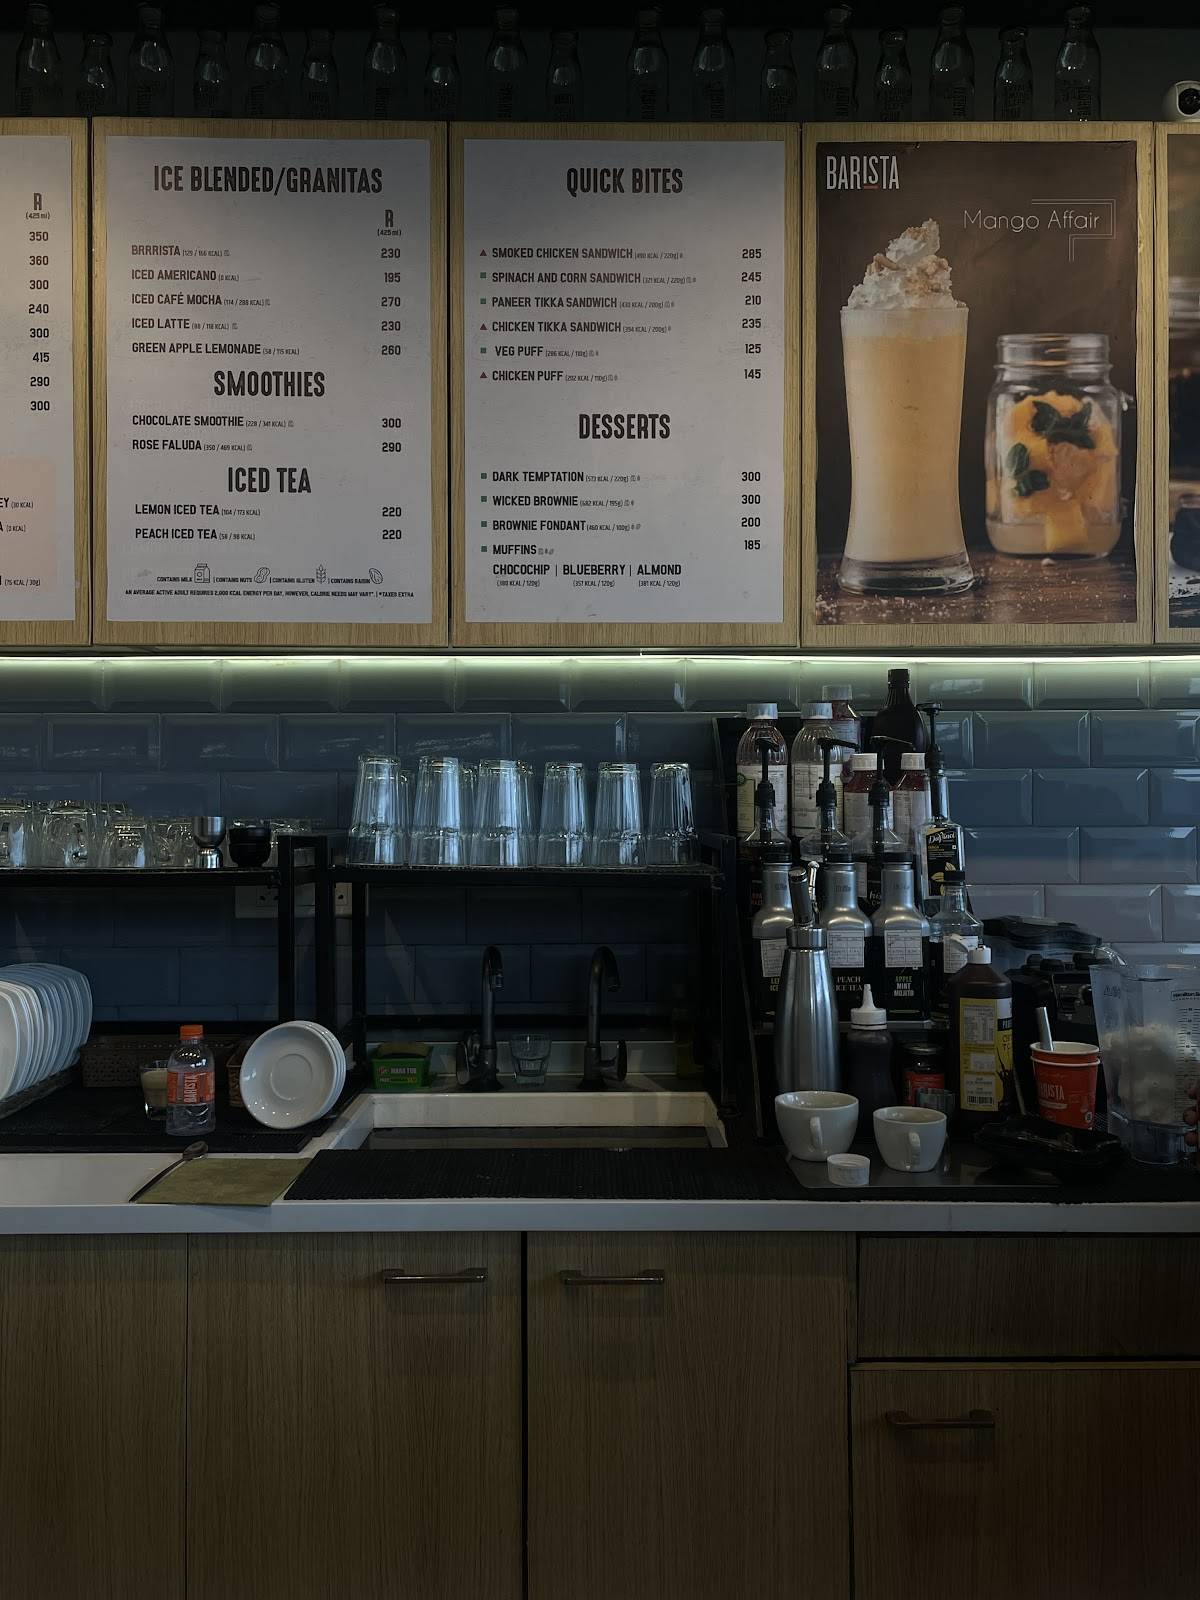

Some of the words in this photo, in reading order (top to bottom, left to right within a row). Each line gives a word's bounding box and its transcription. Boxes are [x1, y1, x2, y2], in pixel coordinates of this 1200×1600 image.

[826, 155, 900, 189] BARISTA
[154, 166, 183, 191] ICE
[191, 166, 382, 196] BLENDED/GRANITAS
[567, 168, 624, 197] QUICK
[632, 168, 683, 193] BITES
[34, 193, 42, 210] R
[385, 209, 393, 227] R
[964, 209, 1040, 232] Mango
[1047, 209, 1101, 230] Affair
[29, 232, 48, 241] 350
[132, 245, 180, 256] BRRRISTA
[381, 248, 400, 258] 230
[492, 248, 533, 258] SMOKED
[536, 248, 578, 258] CHICKEN
[582, 248, 632, 258] SANDWICH
[742, 249, 761, 259] 285
[30, 256, 48, 265] 360
[132, 269, 154, 279] ICED
[158, 270, 216, 280] AMERICANO
[384, 272, 400, 283] 195
[492, 272, 534, 283] SPINACH
[538, 273, 557, 283] AND
[560, 273, 587, 283] CORN
[590, 273, 640, 283] SANDWICH
[742, 272, 761, 282] 245
[30, 280, 48, 289] 300
[132, 294, 154, 304] ICED
[158, 292, 184, 304] CAFÉ
[187, 294, 222, 305] MOCHA
[381, 297, 400, 307] 270
[492, 297, 531, 307] PANEER
[535, 297, 564, 307] TIKKA
[566, 297, 617, 308] SANDWICH
[745, 295, 761, 305] 210
[29, 304, 49, 314] 240
[132, 318, 154, 328] ICED
[158, 318, 190, 329] LATTE
[382, 321, 400, 331] 230
[492, 321, 534, 332] CHICKEN
[538, 322, 567, 332] TIKKA
[570, 322, 621, 332] SANDWICH
[742, 318, 761, 328] 235
[30, 328, 49, 338] 300
[132, 342, 166, 353] GREEN
[169, 343, 202, 353] APPLE
[206, 344, 261, 354] LEMONADE
[382, 345, 401, 355] 260
[495, 346, 514, 356] VEG
[518, 346, 543, 356] PUFF
[745, 344, 761, 354] 125
[33, 352, 49, 362] 415
[493, 370, 534, 381] CHICKEN
[538, 371, 563, 381] PUFF
[744, 369, 761, 379] 145
[30, 377, 49, 387] 290
[214, 371, 325, 397] SMOOTHIES
[31, 401, 50, 411] 300
[133, 415, 191, 426] CHOCOLATE
[194, 416, 244, 426] SMOOTHIE
[382, 418, 401, 428] 300
[579, 414, 670, 439] DESSERTS
[133, 440, 159, 449] ROSE
[162, 440, 202, 450] FALUDA
[382, 442, 401, 452] 290
[228, 467, 270, 492] ICED
[277, 468, 311, 493] TEA
[493, 472, 519, 481] DARK
[522, 472, 583, 482] TEMPTATION
[742, 472, 760, 481] 300
[493, 496, 530, 506] WICKED
[534, 496, 578, 506] BROWNIE
[742, 495, 760, 504] 300
[136, 504, 170, 514] LEMON
[174, 504, 196, 515] ICED
[200, 505, 219, 515] TEA
[382, 507, 401, 517] 220
[493, 520, 537, 530] BROWNIE
[540, 520, 586, 530] FONDANT
[742, 517, 760, 527] 200
[136, 528, 168, 539] PEACH
[172, 529, 194, 539] ICED
[197, 529, 217, 539] TEA
[382, 530, 401, 539] 220
[493, 545, 536, 555] MUFFINS
[745, 540, 760, 550] 185
[493, 564, 550, 575] CHOCOCHIP
[563, 564, 625, 575] BLUEBERRY
[637, 564, 681, 575] ALMOND
[184, 1072, 197, 1103] BARISTA
[1037, 1082, 1065, 1102] ARISTA
